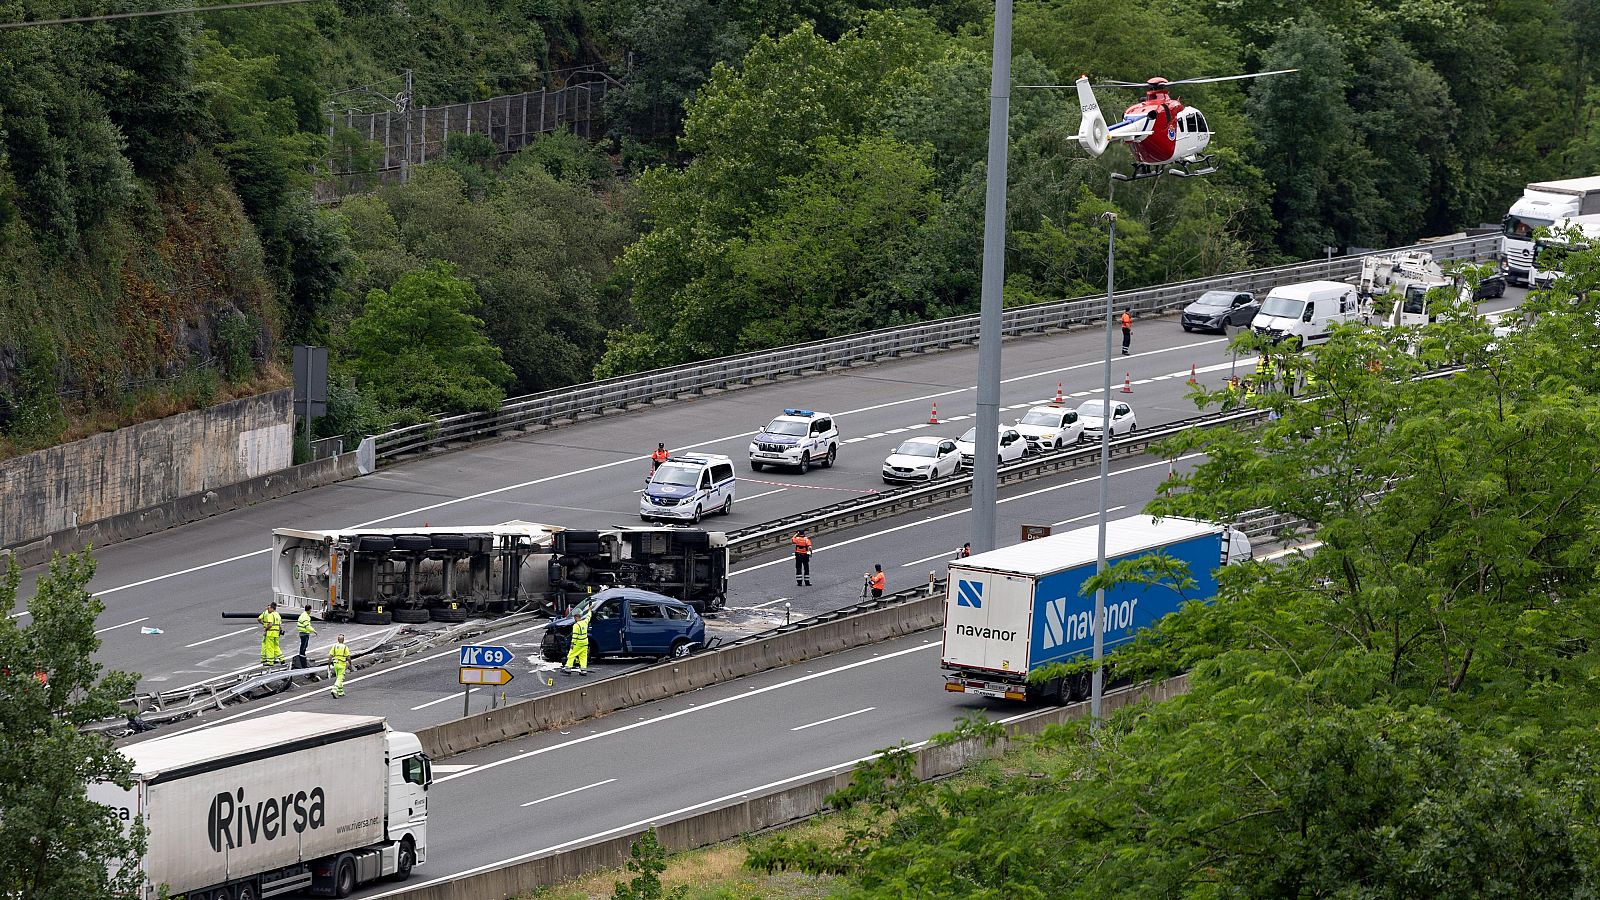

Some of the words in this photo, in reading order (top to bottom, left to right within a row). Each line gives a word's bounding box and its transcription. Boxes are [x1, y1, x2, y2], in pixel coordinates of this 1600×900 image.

[956, 624, 1017, 642] navanor
[484, 650, 504, 663] 69
[207, 786, 325, 853] Riversa
